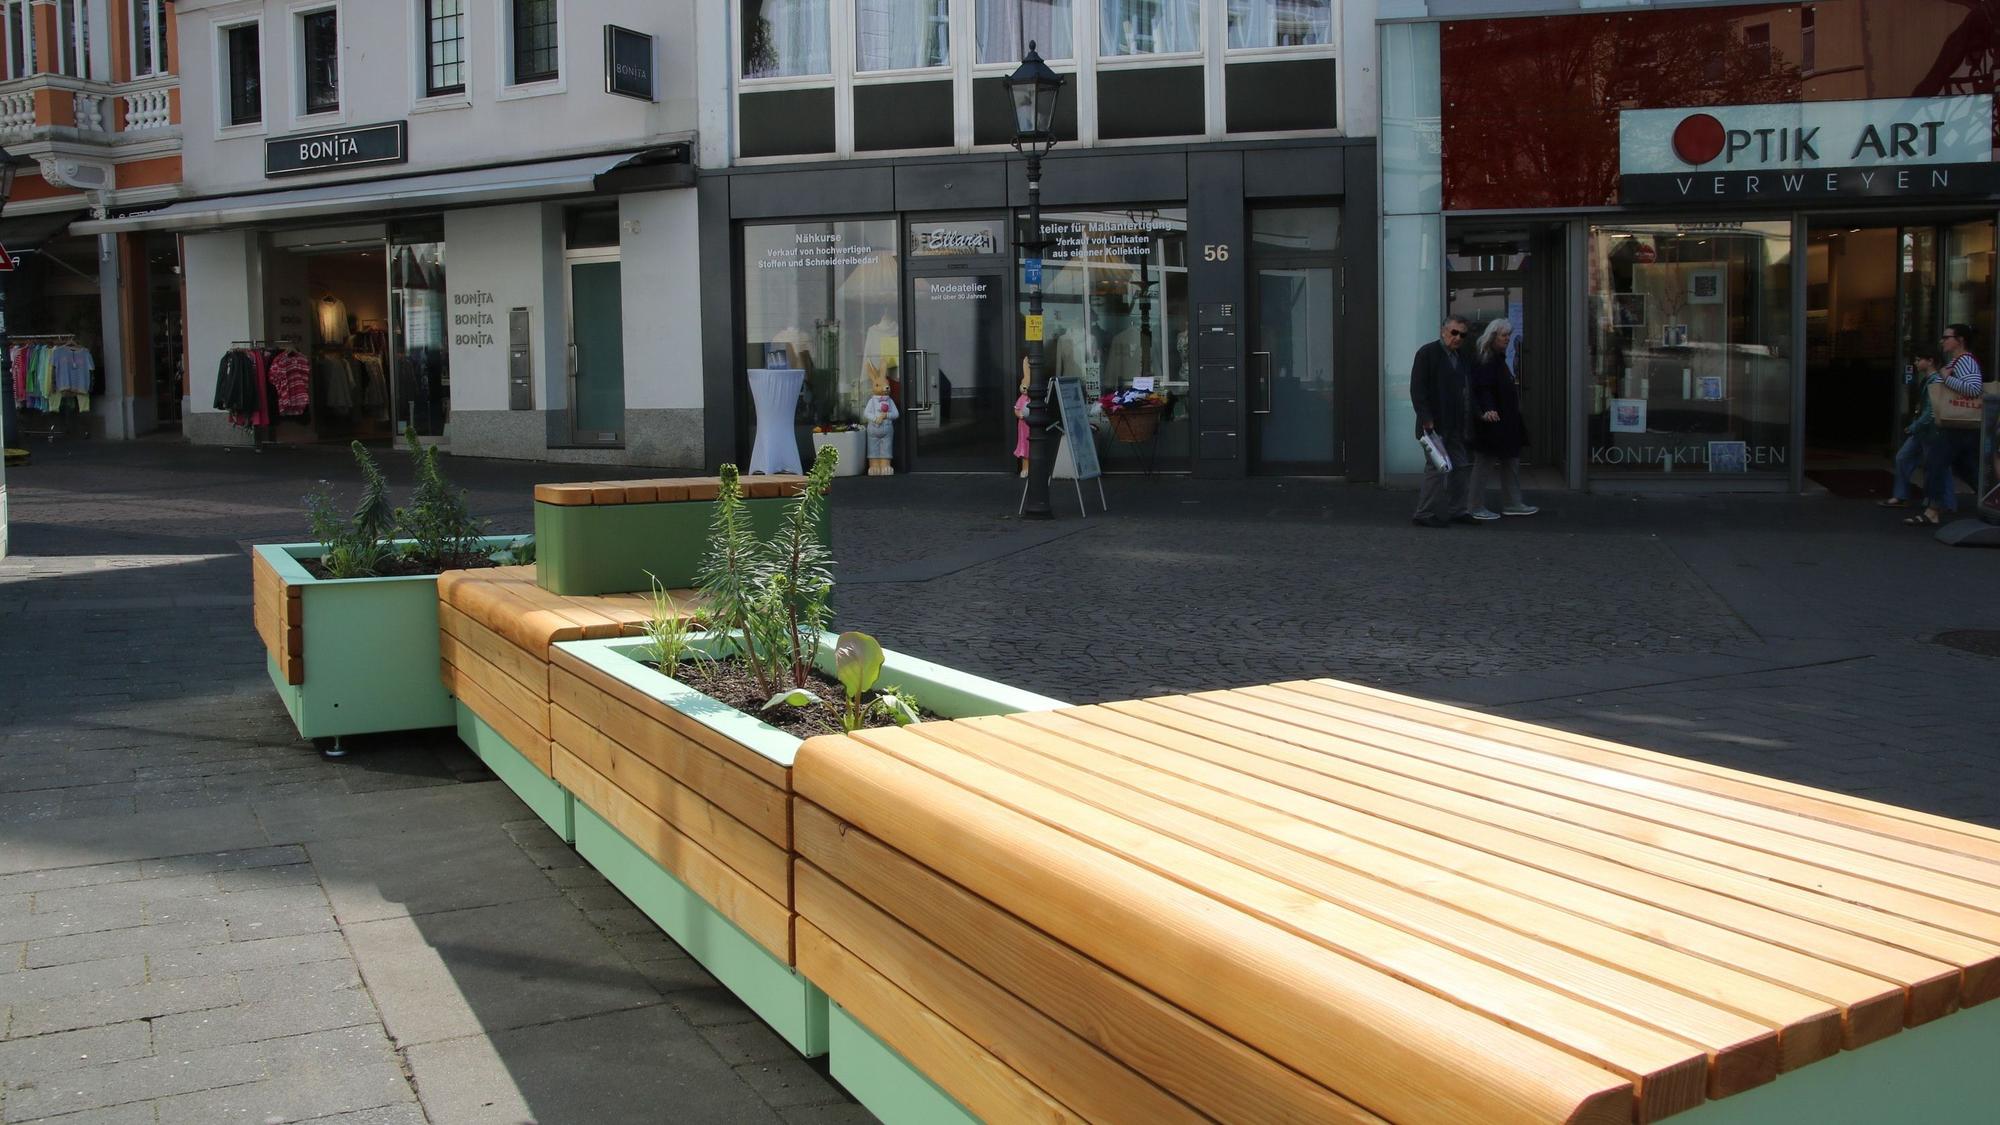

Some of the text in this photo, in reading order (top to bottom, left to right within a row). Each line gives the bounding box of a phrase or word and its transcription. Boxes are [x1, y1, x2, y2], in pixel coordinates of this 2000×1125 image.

[616, 63, 648, 80] BONITA
[300, 135, 358, 161] BONITA
[1851, 121, 1945, 160] ART
[1677, 169, 1948, 196] VERWEYEN
[1039, 222, 1069, 234] telier
[1071, 222, 1086, 233] für
[795, 233, 842, 243] Nähkurse
[1056, 235, 1150, 246] Verkauf von Unikaten
[767, 245, 872, 257] Verkauf von hochwertigen
[1052, 246, 1151, 258] aus eigener Kollektion
[1204, 244, 1229, 261] 56
[758, 255, 879, 269] Stoffen und Schneidereibedarf
[931, 283, 987, 293] Modeatelier
[454, 289, 494, 307] BONITA
[966, 292, 987, 300] Jahren
[455, 311, 494, 328] BONITA
[455, 331, 494, 348] BONITA
